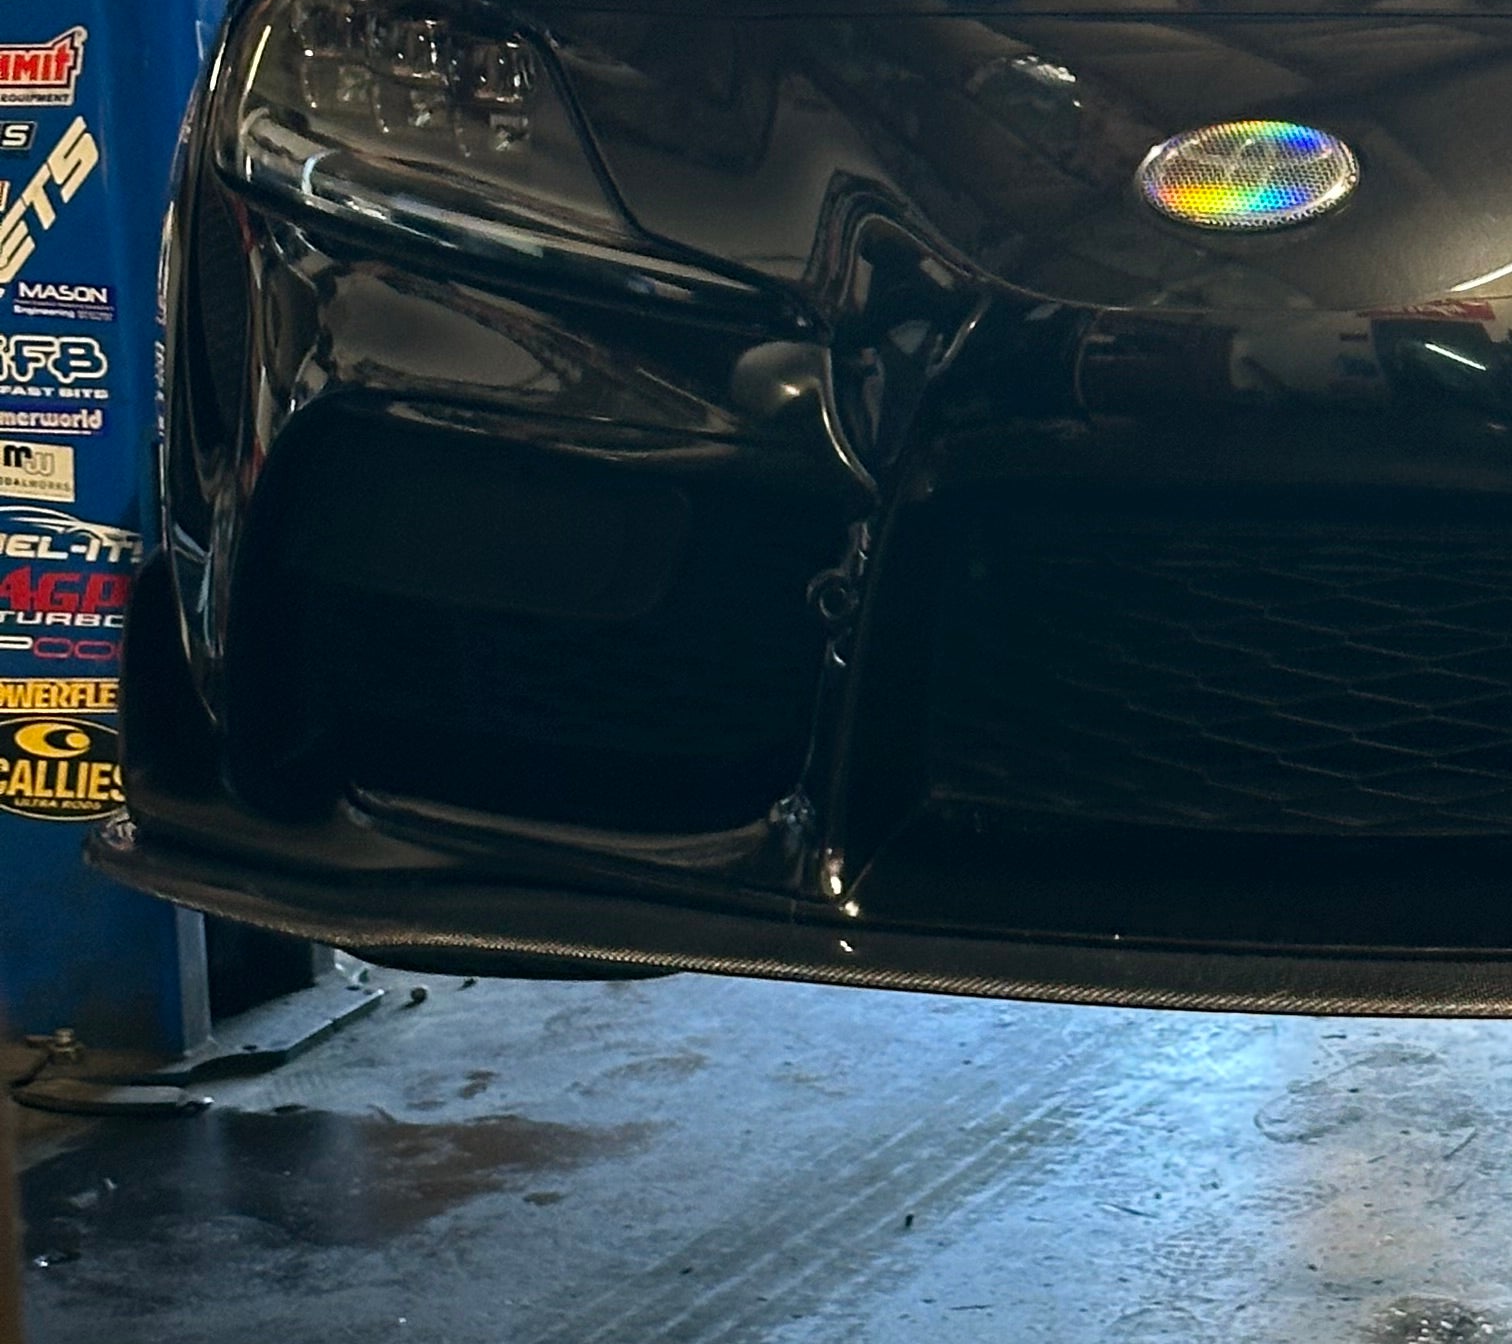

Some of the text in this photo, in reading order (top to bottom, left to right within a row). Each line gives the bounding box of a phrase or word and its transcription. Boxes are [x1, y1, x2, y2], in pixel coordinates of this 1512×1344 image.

[18, 281, 108, 303] MASON
[13, 305, 76, 319] Engineering
[58, 387, 109, 399] BITS
